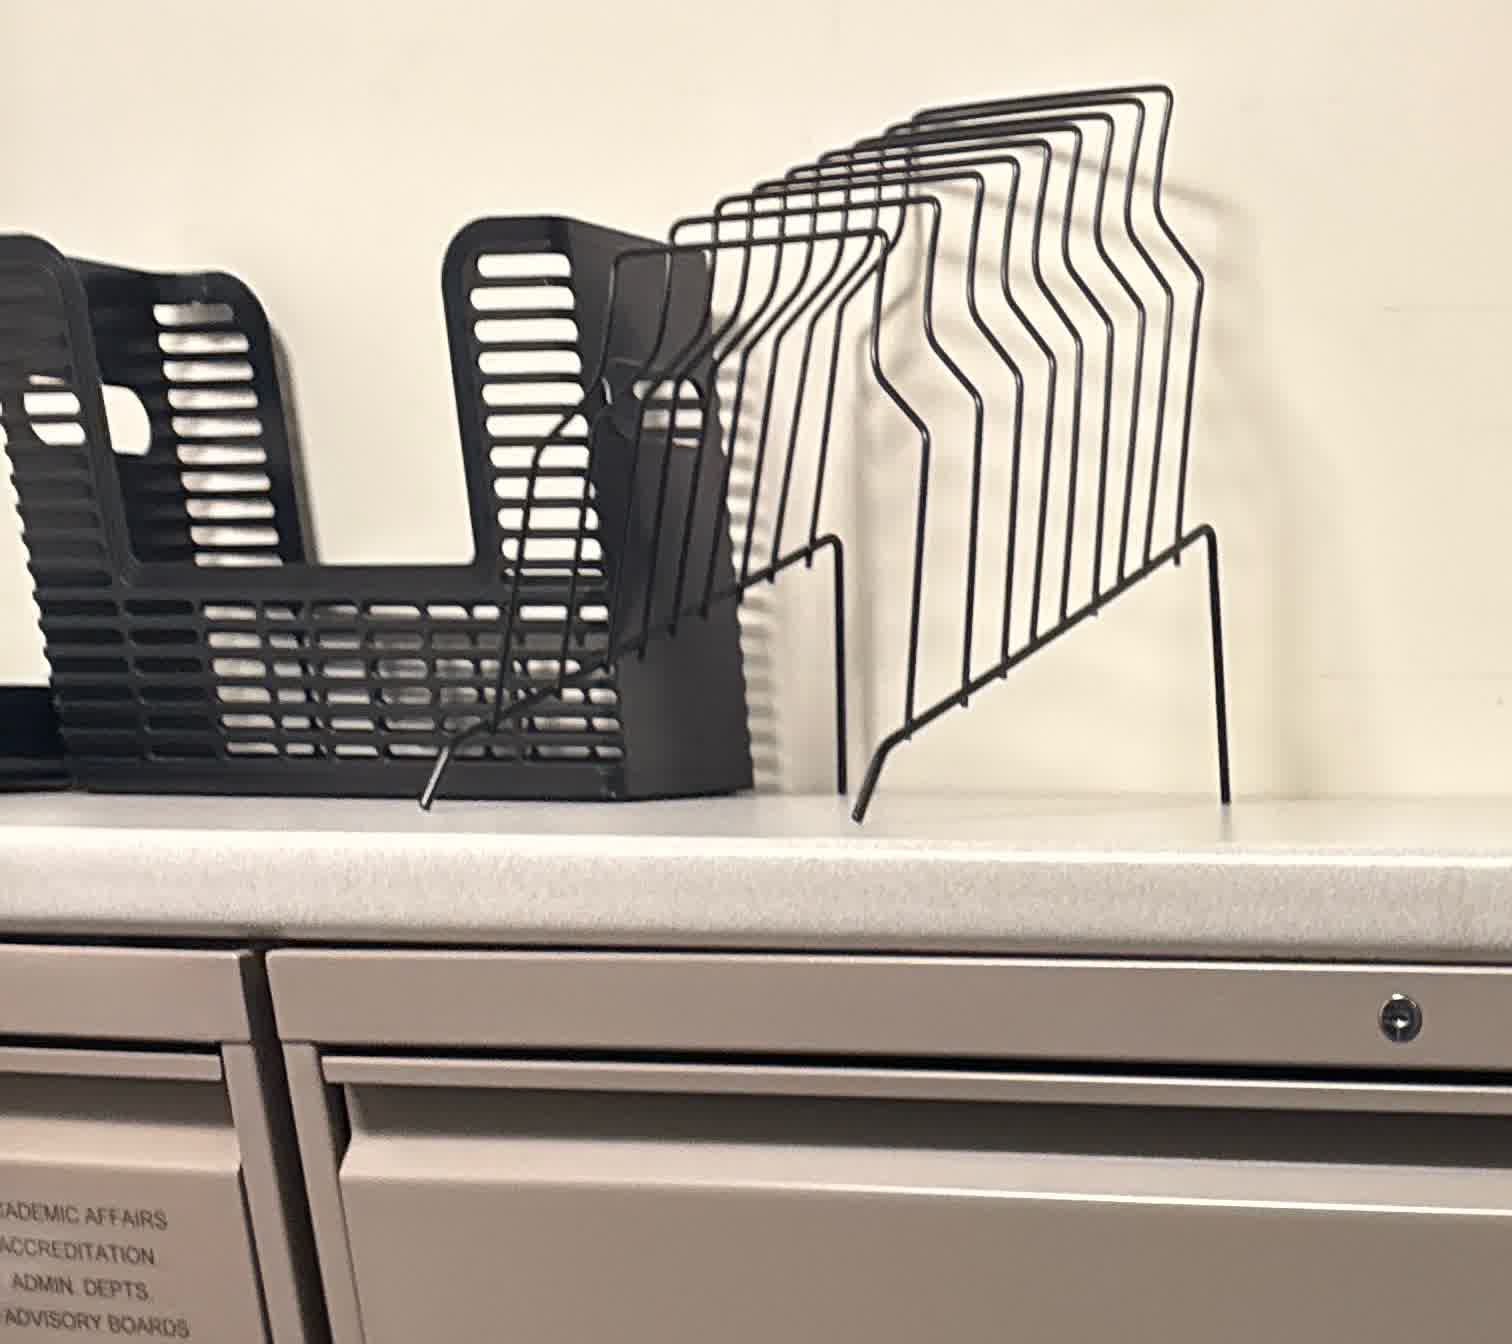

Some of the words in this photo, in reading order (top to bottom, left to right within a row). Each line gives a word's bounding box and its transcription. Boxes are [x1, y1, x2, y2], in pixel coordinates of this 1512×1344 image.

[85, 1207, 168, 1231] AFFAIRS
[0, 1236, 155, 1265] ACCREDITATION
[5, 1308, 101, 1331] ADVISORY
[108, 1315, 190, 1339] BOARDS
